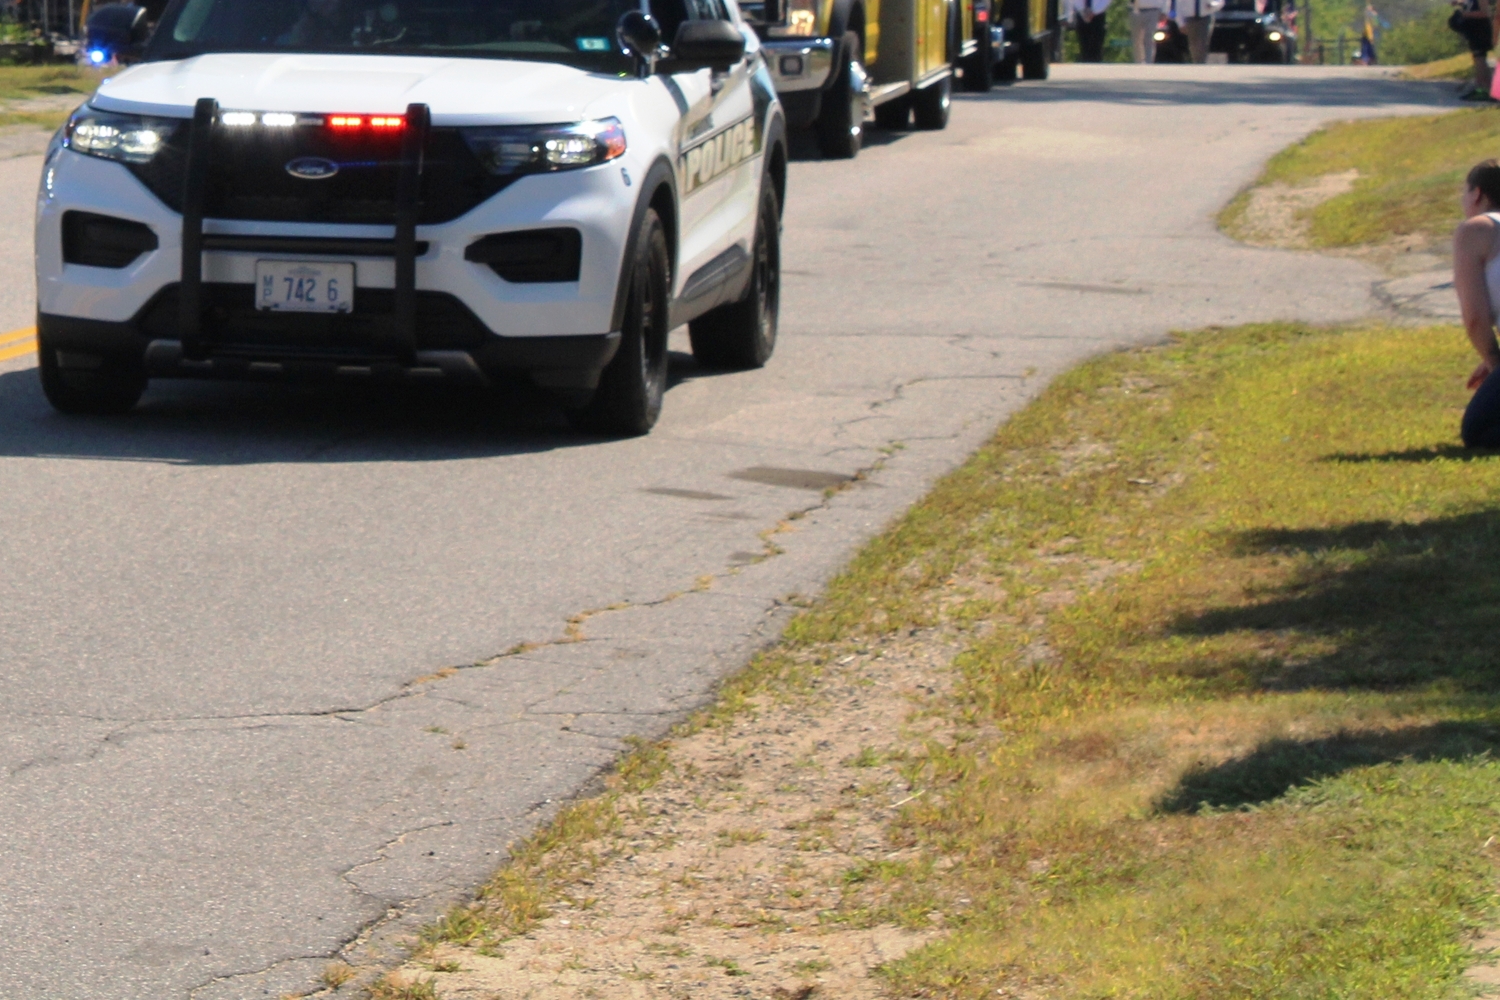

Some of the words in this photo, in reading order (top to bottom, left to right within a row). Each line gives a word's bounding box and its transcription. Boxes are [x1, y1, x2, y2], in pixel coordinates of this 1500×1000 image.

[685, 116, 755, 194] POLICE
[620, 167, 632, 187] 6
[284, 277, 317, 303] 742
[327, 279, 338, 301] 6
